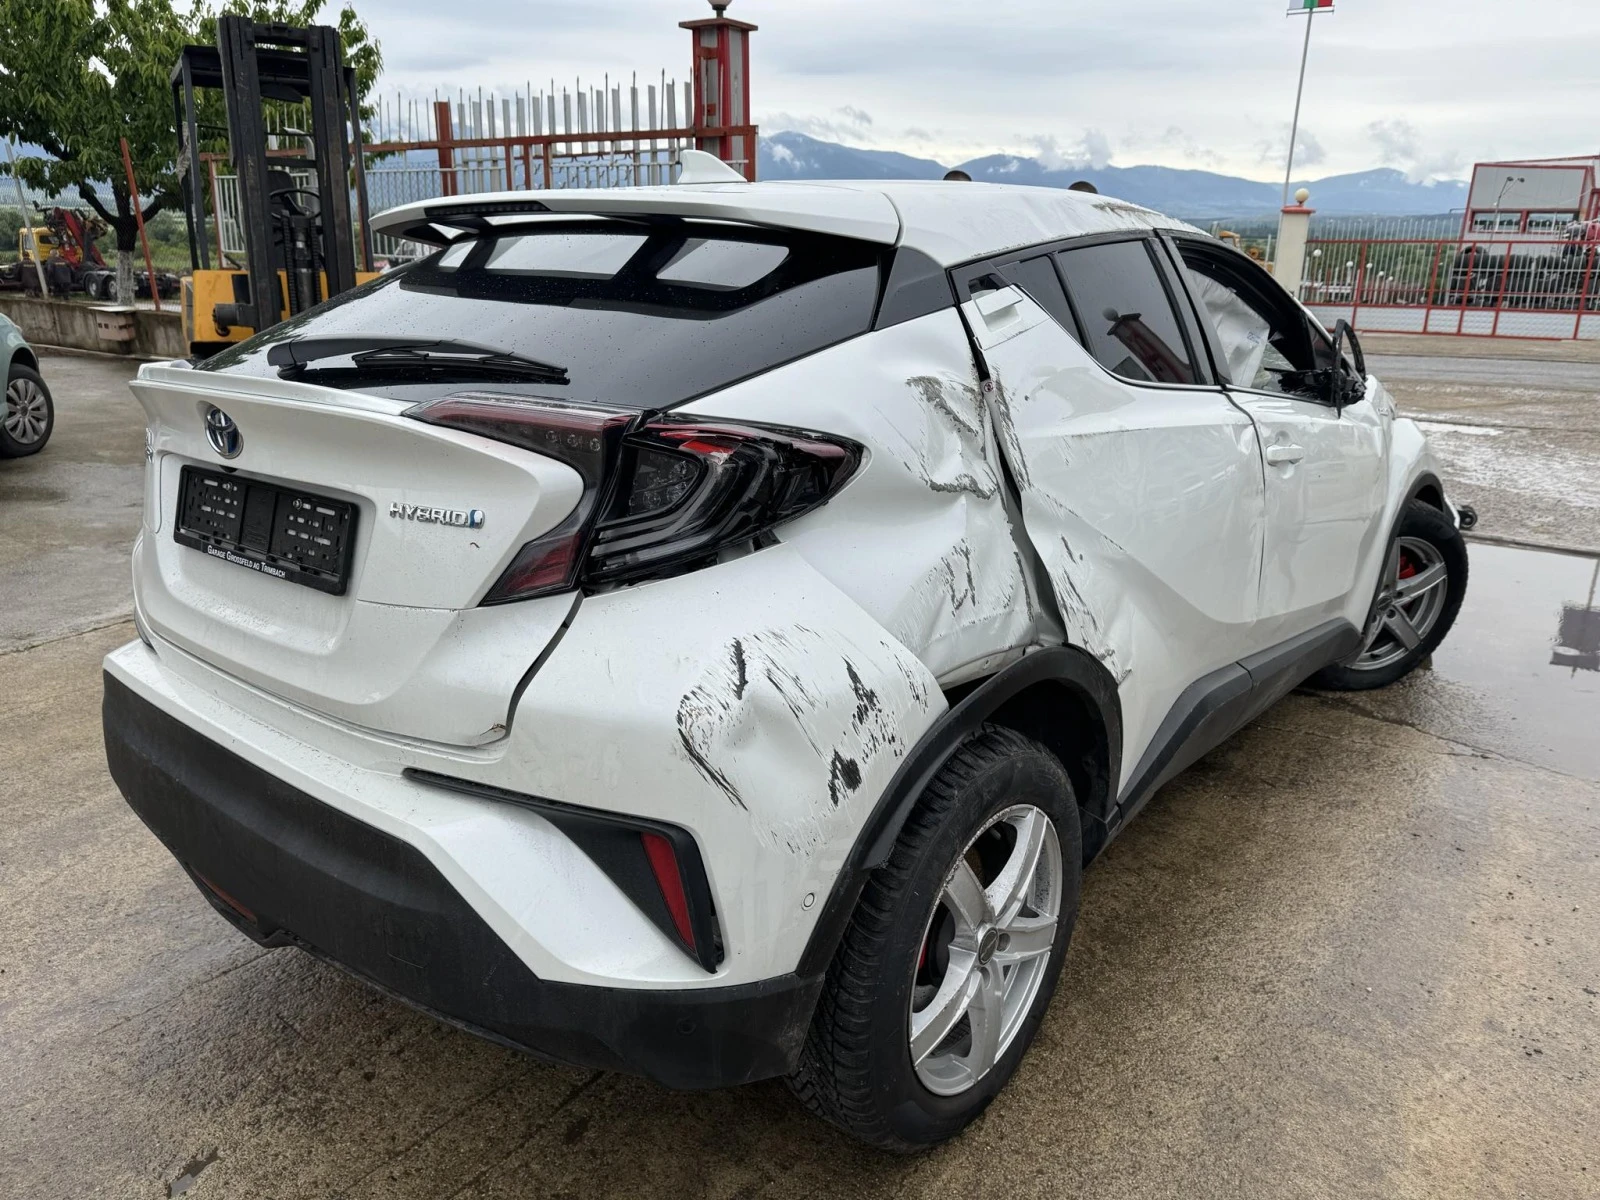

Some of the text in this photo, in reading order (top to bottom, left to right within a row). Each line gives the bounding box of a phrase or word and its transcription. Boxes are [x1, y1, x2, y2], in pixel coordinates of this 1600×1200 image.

[389, 501, 469, 527] HYBRID
[207, 544, 226, 559] GARAGE
[226, 551, 253, 568] GROSSFELD
[261, 561, 286, 579] TRIMBACH
